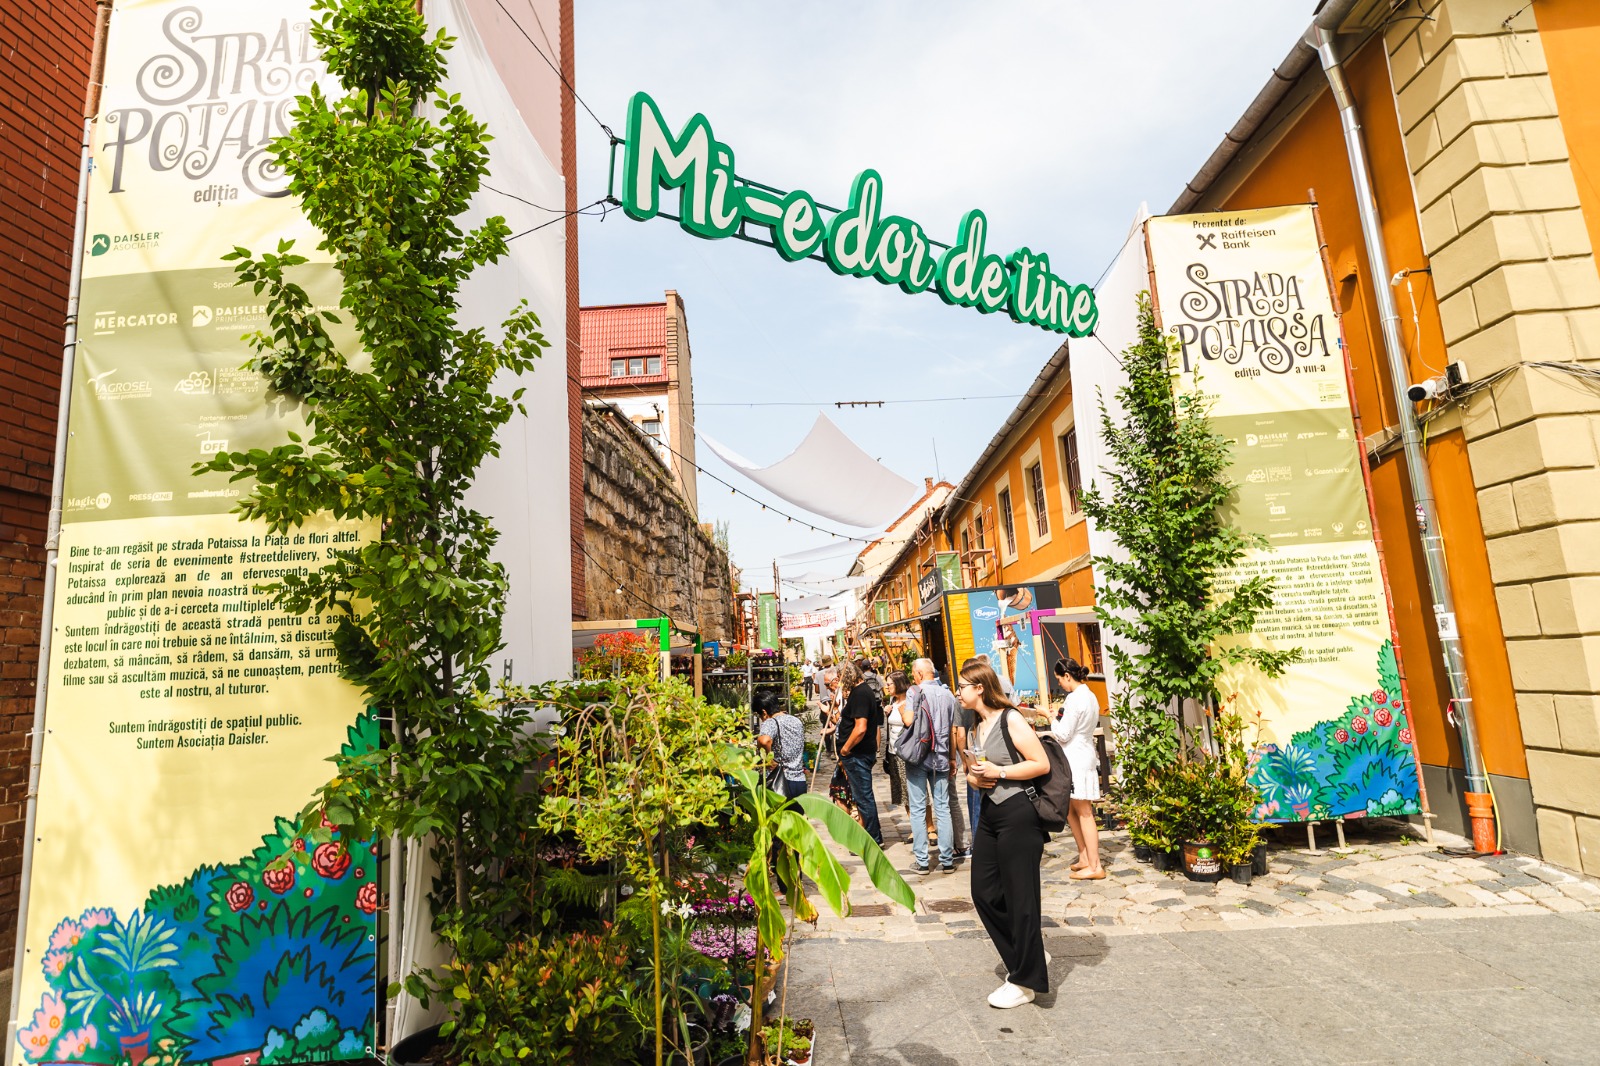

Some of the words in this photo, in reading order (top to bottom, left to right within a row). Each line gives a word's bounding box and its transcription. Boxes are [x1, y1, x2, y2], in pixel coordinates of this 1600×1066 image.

[136, 6, 326, 106] STRAD
[193, 183, 238, 206] ediția
[633, 99, 820, 254] Mi-e
[834, 175, 934, 289] dor
[945, 215, 1009, 308] de
[1016, 253, 1096, 333] tine
[1193, 219, 1231, 229] Prezentat
[1235, 218, 1247, 226] de:
[113, 231, 160, 243] DAISLER
[1221, 228, 1276, 240] Raiffeisen
[1223, 240, 1250, 249] Bank
[1180, 263, 1304, 322] STRADA
[216, 305, 266, 316] DAISLER
[94, 312, 178, 330] MERCATOR
[1170, 313, 1331, 374] POTAISSA
[98, 381, 152, 392] AGROSEL
[204, 442, 226, 451] OFF
[67, 497, 96, 509] Magic
[70, 546, 89, 557] Bine
[94, 545, 119, 555] te-am
[123, 542, 153, 556] regăsit
[157, 542, 167, 553] pe
[172, 539, 203, 550] strada
[208, 537, 248, 549] Potaissa
[252, 536, 260, 547] la
[265, 535, 289, 549] Piața
[293, 534, 305, 545] de
[309, 533, 328, 544] flori
[333, 531, 360, 542] altfel.
[69, 561, 104, 574] Inspirat
[111, 560, 121, 570] de
[128, 558, 150, 569] seria
[157, 556, 167, 567] de
[174, 554, 233, 566] evenimente
[240, 550, 319, 563] #streetdelivery,
[68, 577, 105, 588] Potaissa
[115, 572, 165, 587] explorează
[175, 573, 186, 582] an
[197, 570, 210, 581] de
[221, 571, 232, 580] an
[67, 592, 105, 605] aducând
[109, 591, 117, 602] în
[122, 591, 143, 604] prim
[147, 588, 167, 602] plan
[172, 587, 203, 598] nevoia
[208, 583, 248, 597] noastră
[107, 606, 135, 620] public
[139, 605, 146, 620] și
[150, 605, 160, 616] de
[165, 604, 177, 615] a-i
[181, 602, 218, 614] cerceta
[222, 599, 275, 613] multiplele
[65, 626, 99, 637] Suntem
[105, 621, 159, 636] îndrăgostiți
[165, 620, 176, 631] de
[182, 619, 221, 630] această
[227, 616, 262, 629] stradă
[268, 615, 301, 629] pentru
[65, 642, 82, 653] este
[86, 640, 107, 652] locul
[110, 639, 118, 650] în
[122, 640, 142, 650] care
[145, 638, 159, 648] noi
[163, 636, 197, 647] trebuie
[201, 634, 211, 646] să
[215, 636, 227, 645] ne
[230, 632, 277, 645] întâlnim,
[281, 631, 292, 642] să
[64, 658, 109, 669] dezbatem,
[114, 656, 123, 667] să
[129, 654, 172, 666] mâncăm,
[177, 652, 188, 664] să
[193, 651, 228, 663] râdem,
[233, 650, 243, 661] să
[250, 648, 292, 660] dansăm,
[299, 647, 310, 658] să
[63, 674, 85, 686] filme
[89, 675, 104, 685] sau
[108, 672, 118, 683] să
[122, 670, 165, 683] ascultăm
[170, 668, 208, 681] muzică,
[212, 667, 223, 678] să
[228, 669, 239, 678] ne
[244, 665, 303, 680] cunoaștem,
[140, 687, 160, 698] este
[164, 686, 172, 697] al
[177, 685, 211, 697] nostru,
[216, 683, 224, 695] al
[229, 683, 269, 694] tuturor.
[109, 721, 144, 733] Suntem
[149, 717, 206, 733] îndrăgostiți
[211, 717, 222, 729] de
[227, 715, 262, 731] spațiul
[266, 714, 301, 729] public.
[137, 737, 173, 749] Suntem
[177, 734, 224, 750] Asociația
[229, 732, 268, 745] Daisler.
